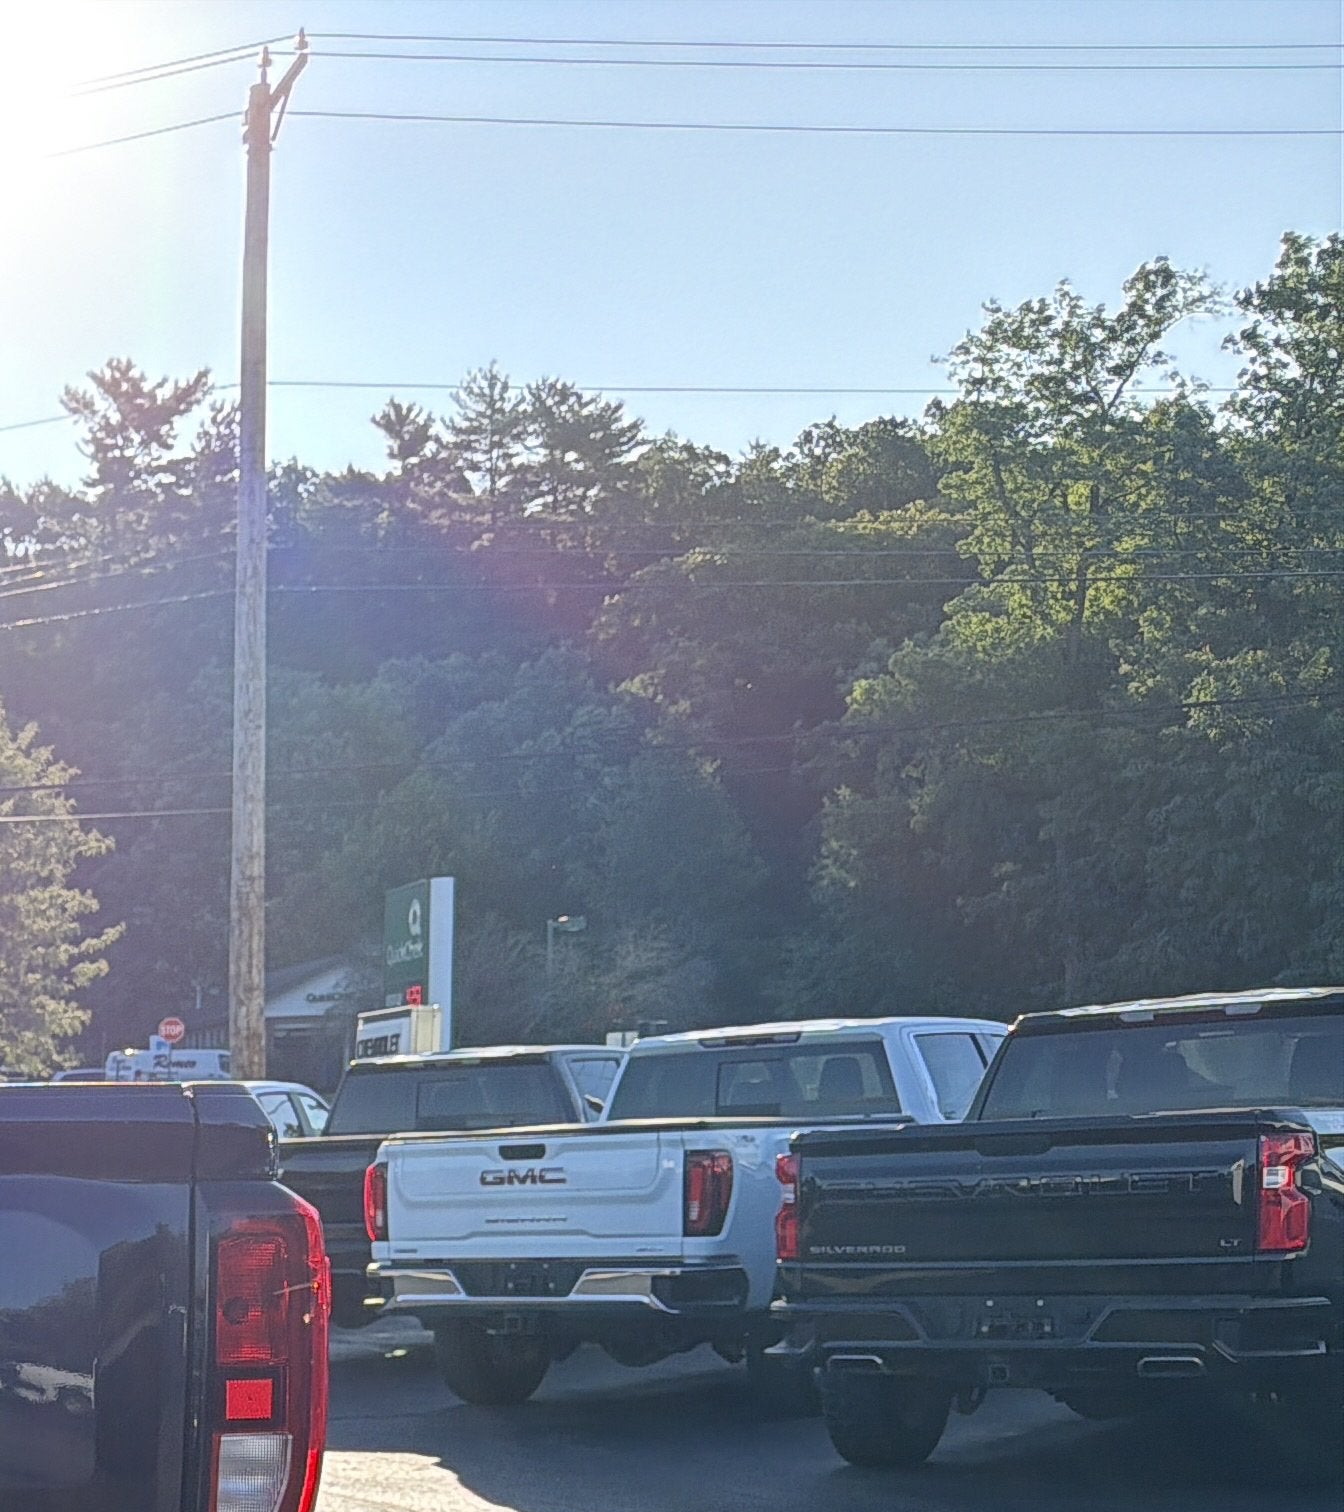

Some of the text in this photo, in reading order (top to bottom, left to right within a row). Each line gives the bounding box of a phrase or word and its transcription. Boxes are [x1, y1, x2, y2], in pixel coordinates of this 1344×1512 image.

[159, 1024, 184, 1036] STOP
[479, 1167, 568, 1187] GMC
[1220, 1237, 1242, 1248] LT
[809, 1245, 908, 1256] SILVERADO
